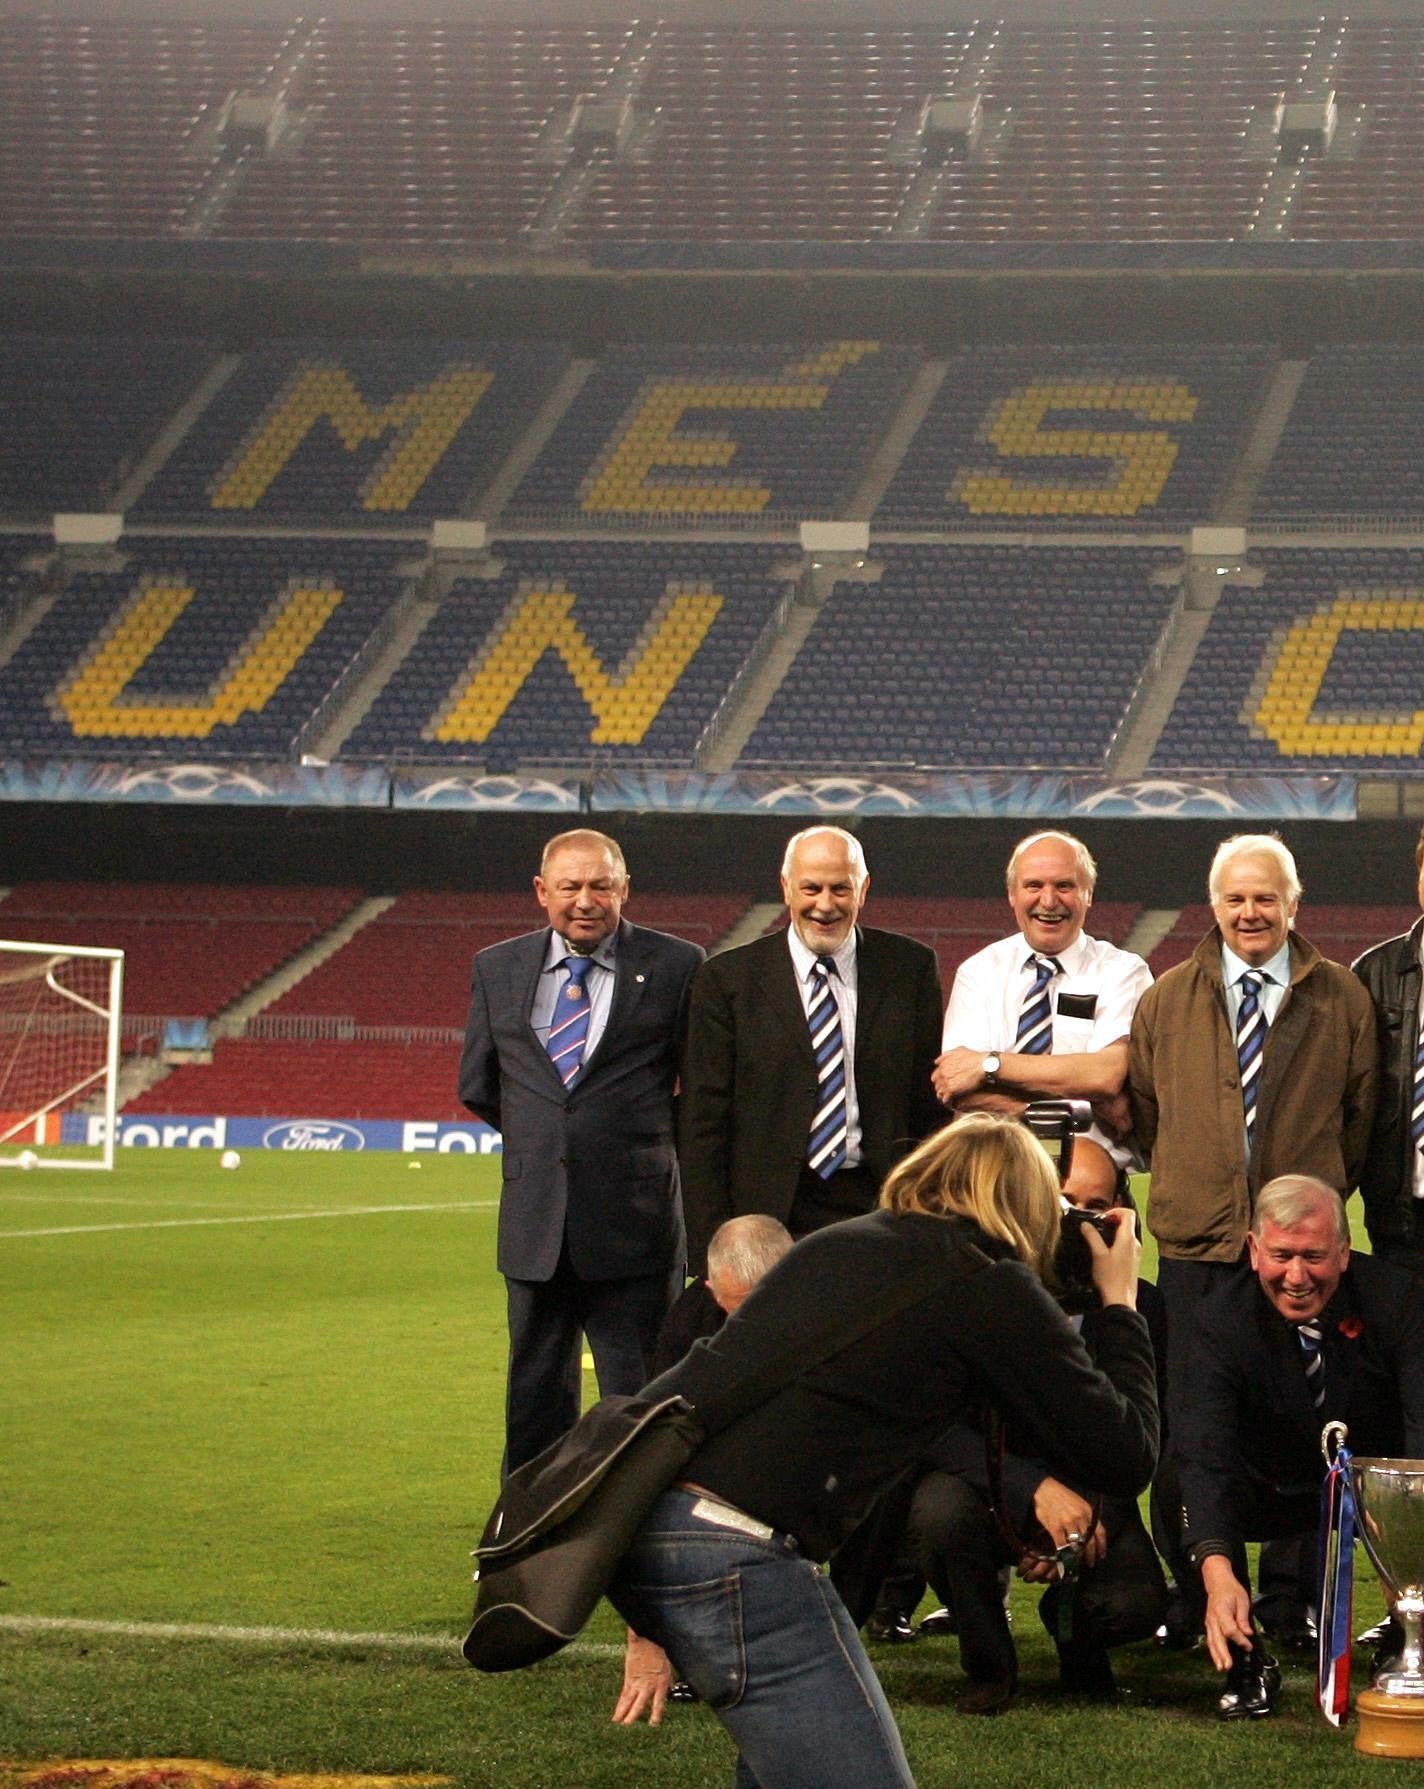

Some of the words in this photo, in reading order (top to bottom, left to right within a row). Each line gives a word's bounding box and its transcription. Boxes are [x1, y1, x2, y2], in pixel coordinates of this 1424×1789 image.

[208, 340, 1199, 516] MÉS
[48, 576, 725, 746] UN
[86, 1115, 228, 1149] Ford
[281, 1126, 346, 1150] Ford
[402, 1121, 503, 1154] For
